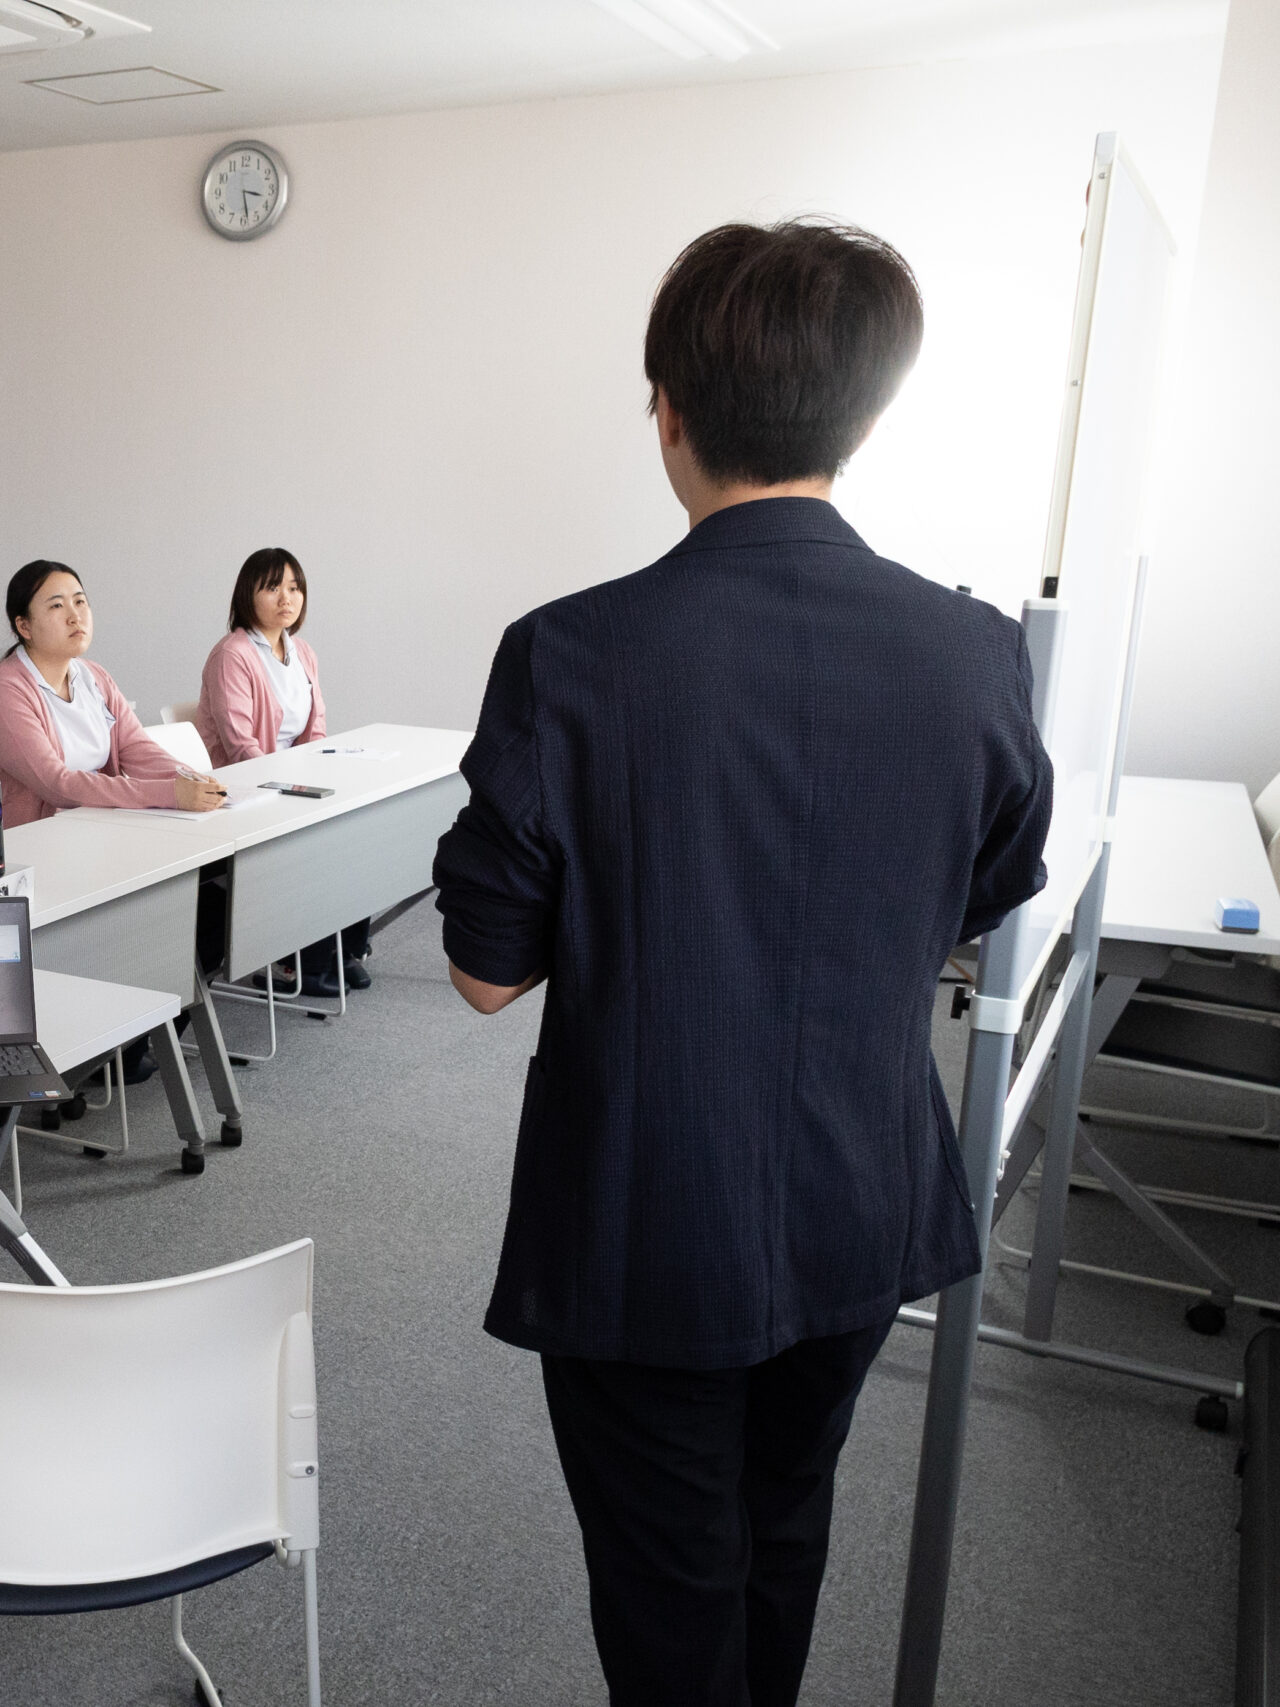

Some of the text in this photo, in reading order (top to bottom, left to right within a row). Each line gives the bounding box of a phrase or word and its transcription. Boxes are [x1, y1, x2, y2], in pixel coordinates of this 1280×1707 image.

[228, 160, 236, 172] 11
[241, 155, 250, 167] 12
[256, 158, 260, 170] 1
[219, 172, 228, 184] 10
[264, 168, 271, 180] 2
[215, 188, 221, 200] 9
[268, 184, 275, 196] 3
[219, 203, 225, 214] 8
[263, 199, 269, 211] 4
[228, 213, 235, 224] 7
[239, 215, 247, 226] 6
[253, 211, 259, 222] 5
